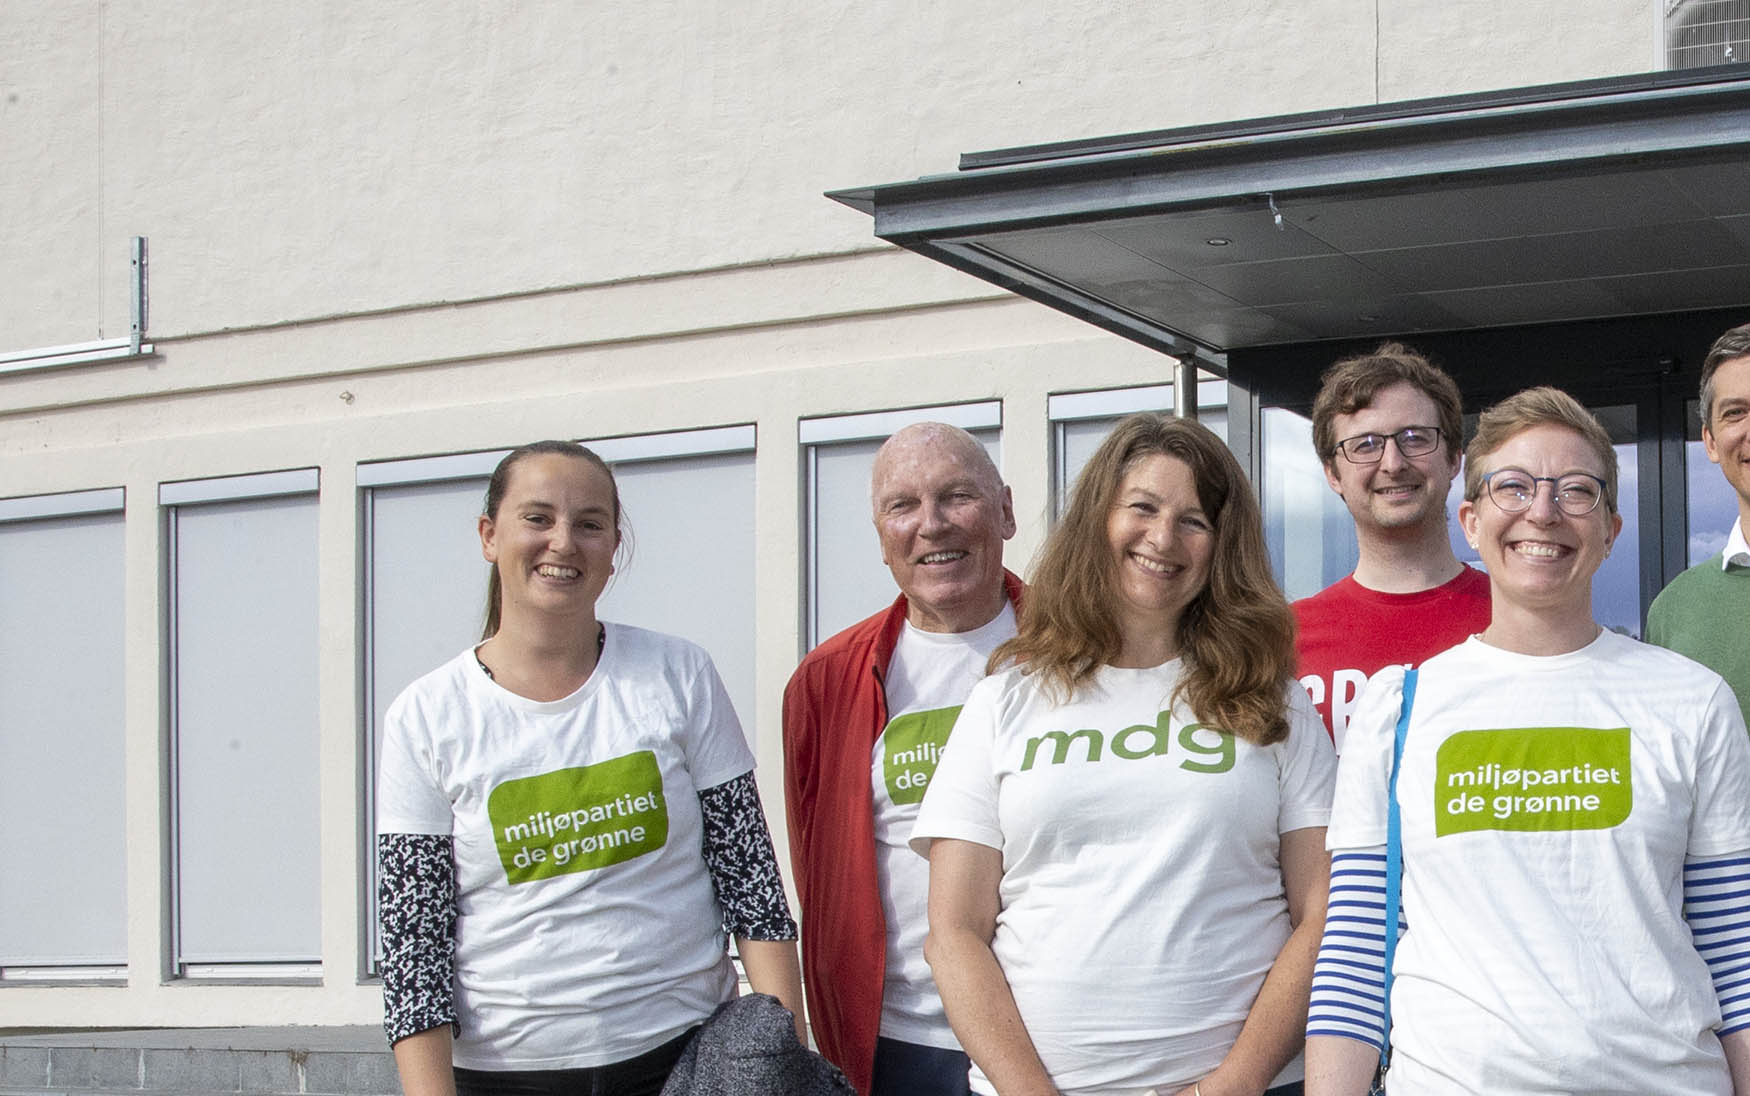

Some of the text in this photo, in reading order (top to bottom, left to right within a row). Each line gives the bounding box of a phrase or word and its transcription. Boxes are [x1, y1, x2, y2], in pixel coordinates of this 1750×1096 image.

[1019, 710, 1236, 774] mdg
[895, 769, 928, 790] de
[1447, 762, 1621, 791] miljøpartiet
[504, 791, 659, 843] miljøpartiet
[1447, 792, 1602, 819] de grønne
[512, 825, 646, 869] de grønne
